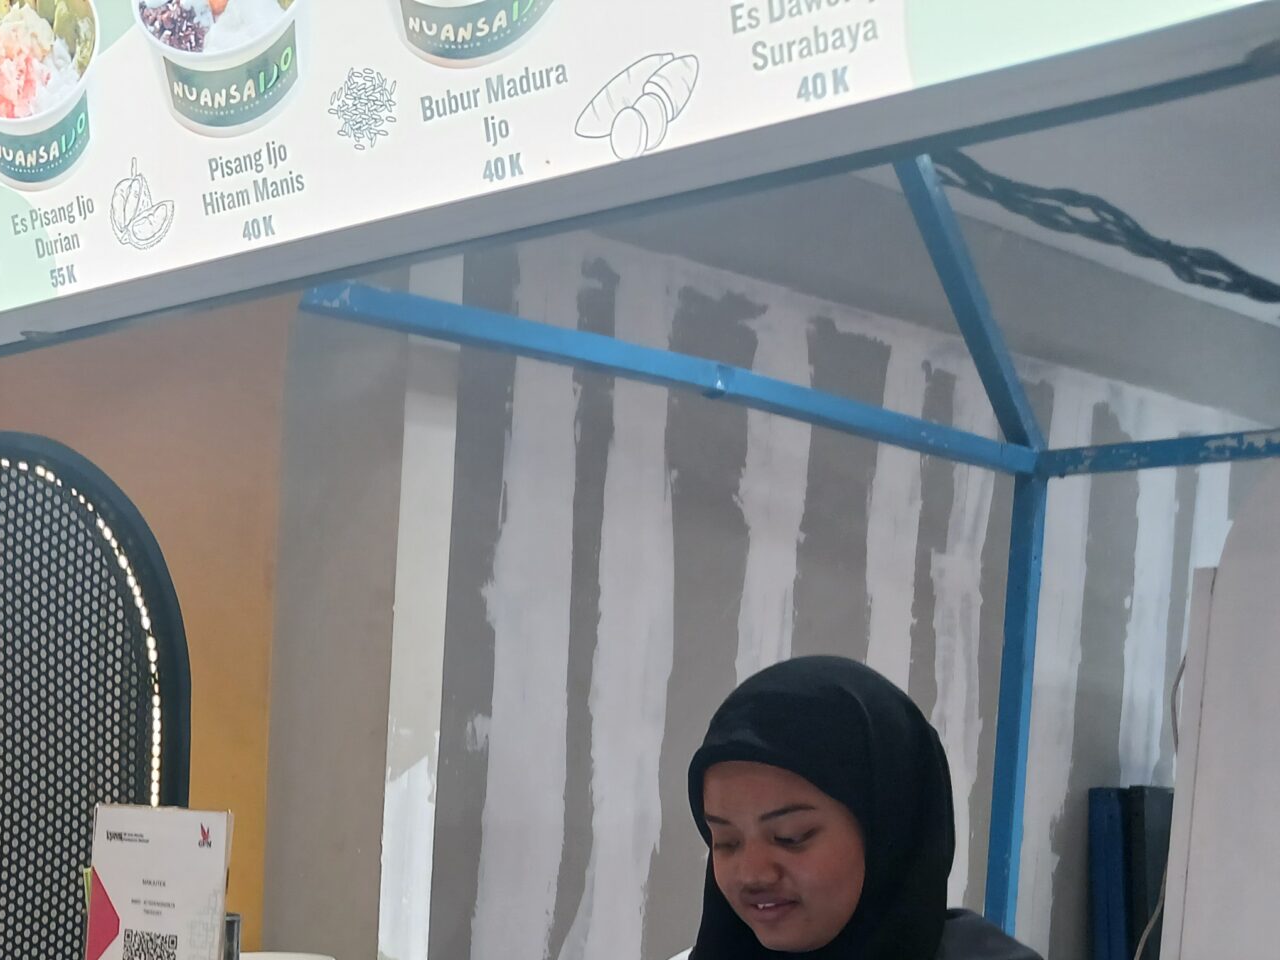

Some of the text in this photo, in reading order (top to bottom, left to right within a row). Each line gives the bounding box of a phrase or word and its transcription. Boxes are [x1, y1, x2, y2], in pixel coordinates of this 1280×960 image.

[730, 3, 761, 34] Es
[751, 18, 879, 71] Surabaya
[173, 46, 294, 109] NUANSAIJO
[420, 64, 568, 122] Bubur Madura
[796, 65, 850, 102] 40 K
[483, 115, 510, 147] Ijo
[207, 141, 287, 181] Pisang Ijo
[482, 152, 524, 183] 40 K
[202, 171, 305, 216] Hitam Manis
[11, 195, 95, 236] Es Pisang Ijo
[242, 214, 276, 241] 40 K
[35, 232, 81, 259] Durian
[49, 267, 66, 288] 55
